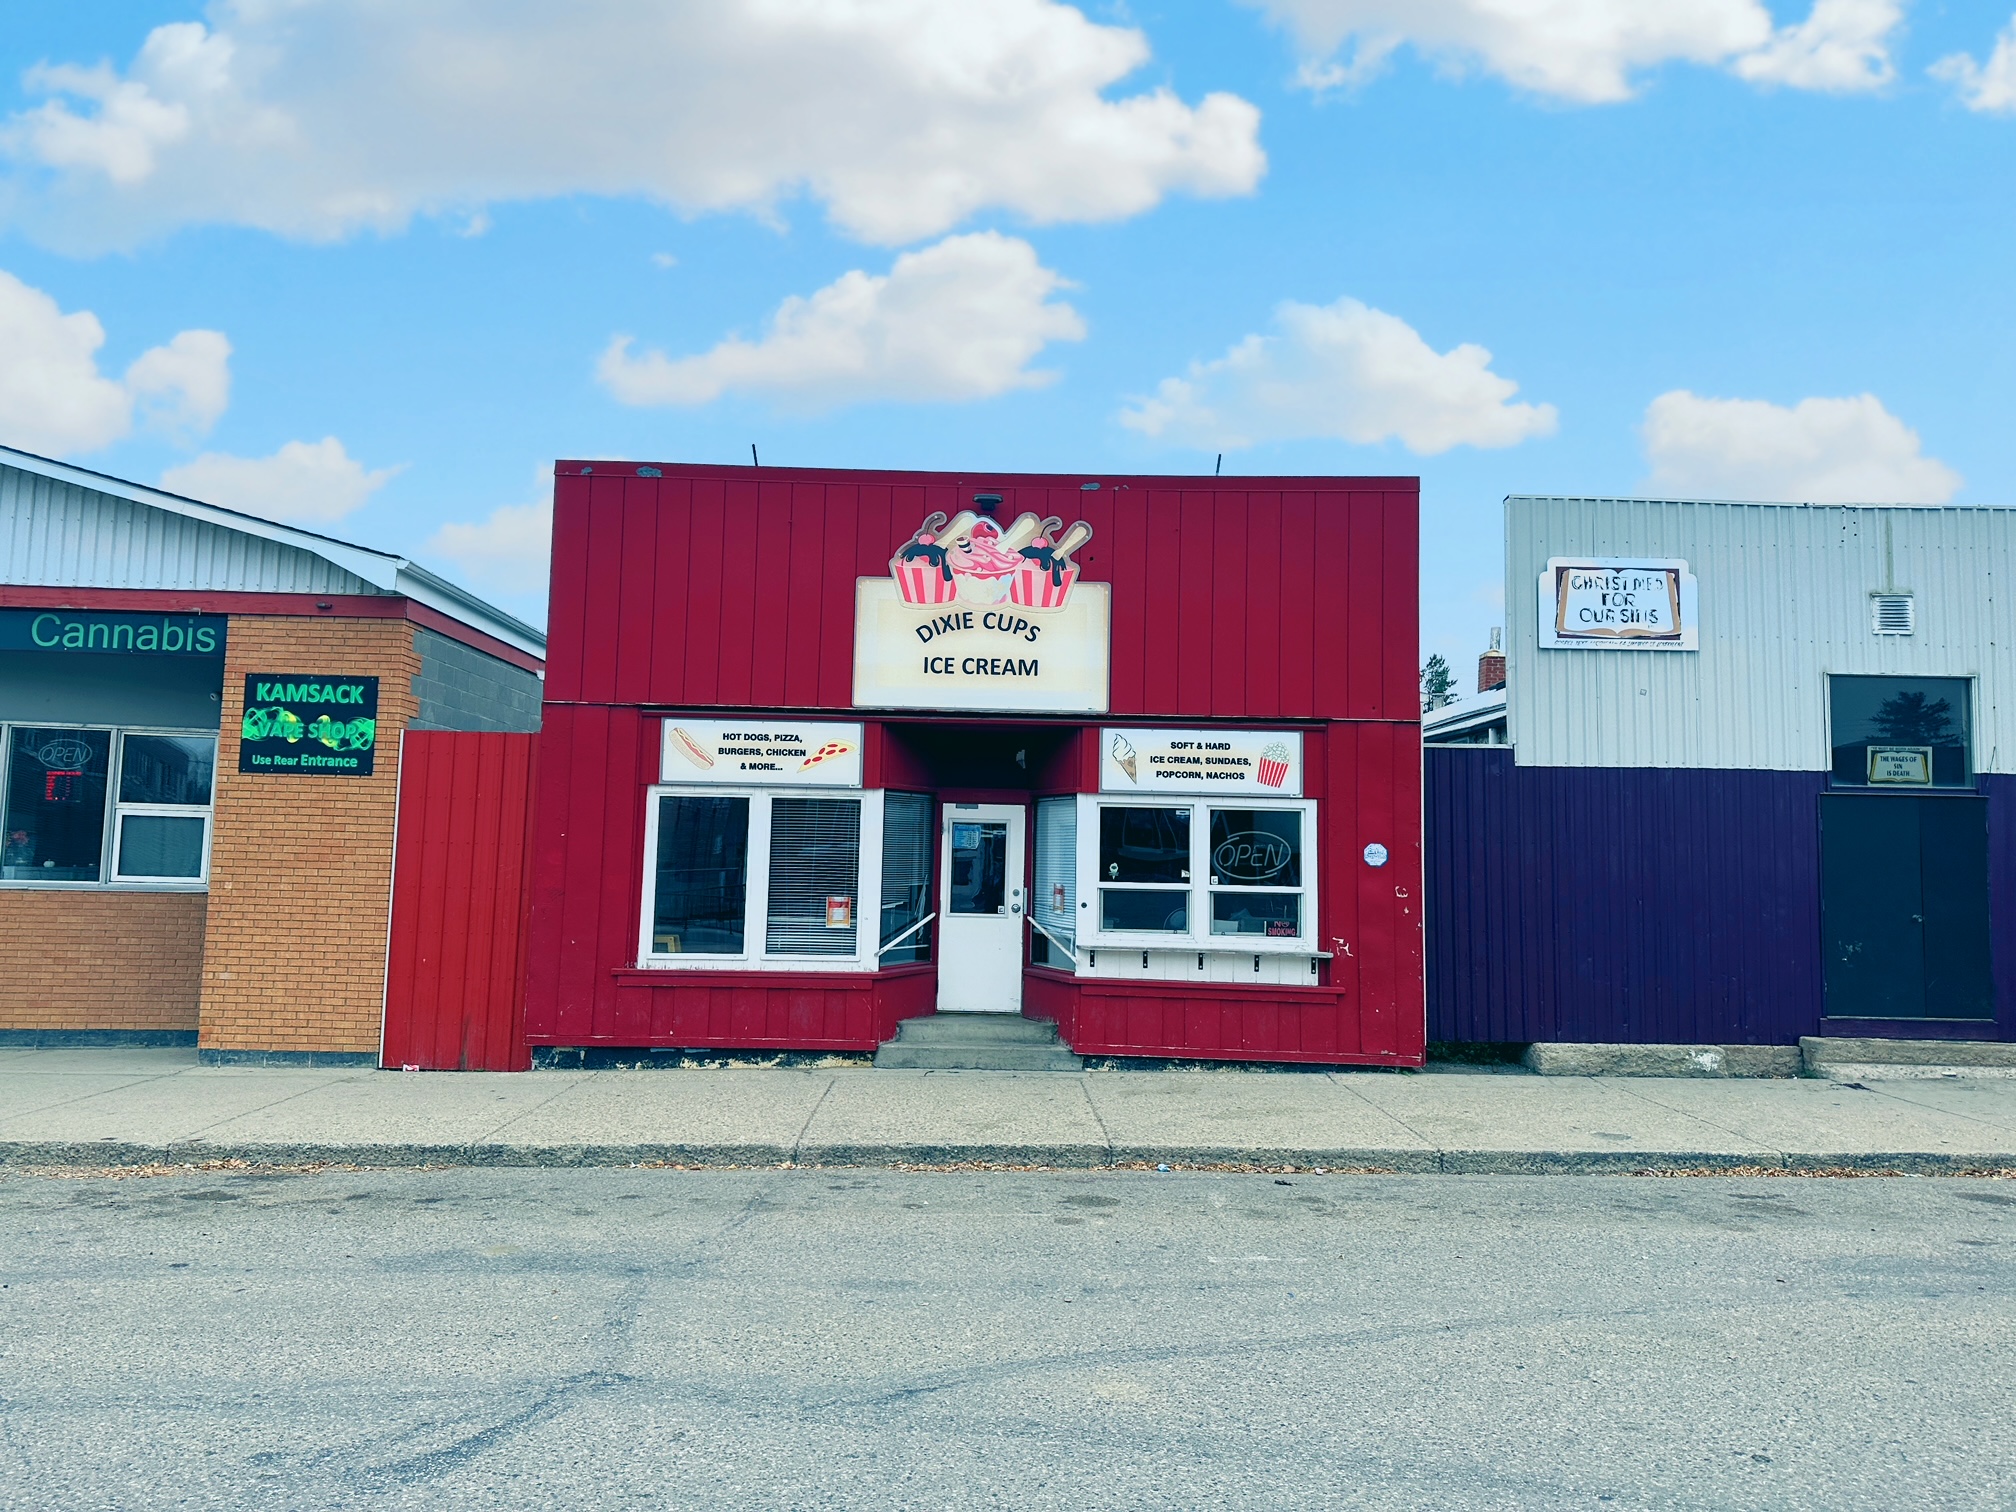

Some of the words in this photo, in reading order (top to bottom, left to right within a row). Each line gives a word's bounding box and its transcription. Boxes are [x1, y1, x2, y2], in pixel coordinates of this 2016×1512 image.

[1571, 575, 1628, 591] CHRIST
[1601, 592, 1636, 607] FOR
[1579, 608, 1615, 623] OUR
[31, 613, 217, 652] Cannabis
[915, 611, 974, 643] DIXIE
[982, 612, 1041, 642] CUPS
[923, 656, 955, 675] ICE
[961, 657, 1039, 677] CREAM
[256, 682, 364, 704] KAMSACK
[260, 721, 304, 738] VAPE
[307, 721, 357, 739] SHOP
[722, 732, 742, 741] HOT
[743, 733, 772, 742] DOGS,
[774, 734, 803, 743] PIZZA,
[718, 747, 764, 757] BURGERS,
[765, 748, 806, 757] CHICKEN
[1170, 741, 1195, 750] SOFT
[1196, 742, 1203, 750] &
[1205, 743, 1231, 751] HARD
[42, 746, 87, 762] OPEN
[252, 754, 272, 765] Use
[274, 755, 298, 766] Rear
[300, 754, 358, 767] Entrance
[1149, 755, 1164, 764] ICE
[1167, 756, 1203, 766] CREAM,
[1205, 757, 1252, 767] SUNDAES,
[1880, 755, 1890, 763] THE
[740, 762, 747, 771] &
[749, 762, 783, 771] MORE...
[1156, 770, 1204, 780] POPCORN,
[1206, 771, 1245, 780] NACHOS
[1218, 843, 1284, 867] OPEN
[1273, 920, 1290, 928] NO
[1267, 927, 1296, 937] SMOKING
